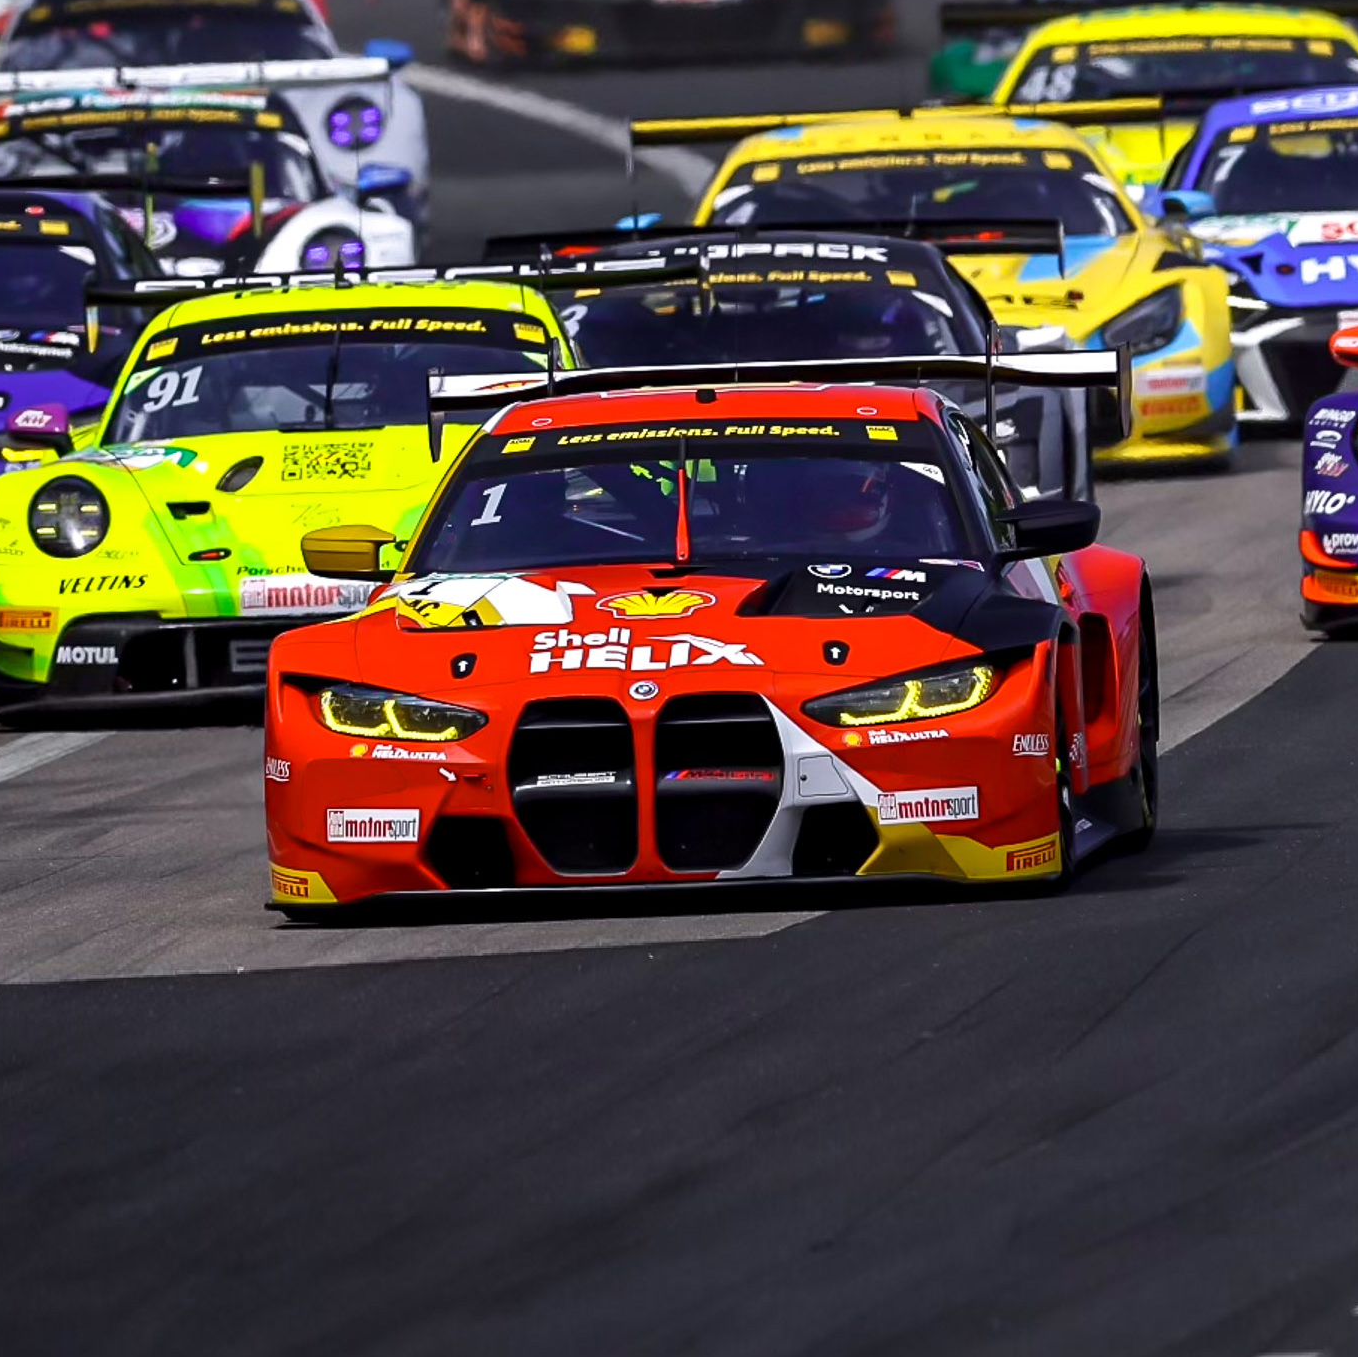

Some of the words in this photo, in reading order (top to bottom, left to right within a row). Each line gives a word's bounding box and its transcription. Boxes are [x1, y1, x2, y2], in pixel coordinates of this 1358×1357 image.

[1214, 146, 1246, 183] 7
[201, 329, 247, 345] Less
[249, 320, 363, 340] emissions.
[369, 317, 416, 332] Full
[416, 318, 486, 334] Speed.
[143, 365, 204, 414] 91
[557, 429, 602, 446] Less
[606, 424, 719, 442] emissions.
[724, 424, 766, 437] Full
[769, 424, 840, 438] Speed.
[470, 483, 509, 528] 1
[236, 565, 306, 577] Porsche
[58, 574, 149, 595] VELTINS
[816, 582, 920, 601] Motorsport
[0, 610, 52, 629] PIRELLI
[533, 627, 631, 649] Shell
[56, 645, 119, 665] MOTUL
[529, 634, 766, 673] HELIX
[1012, 733, 1050, 753] ENDLESS
[897, 793, 977, 820] motorsport
[344, 816, 417, 840] motorsport
[1006, 841, 1056, 872] PIRELLI
